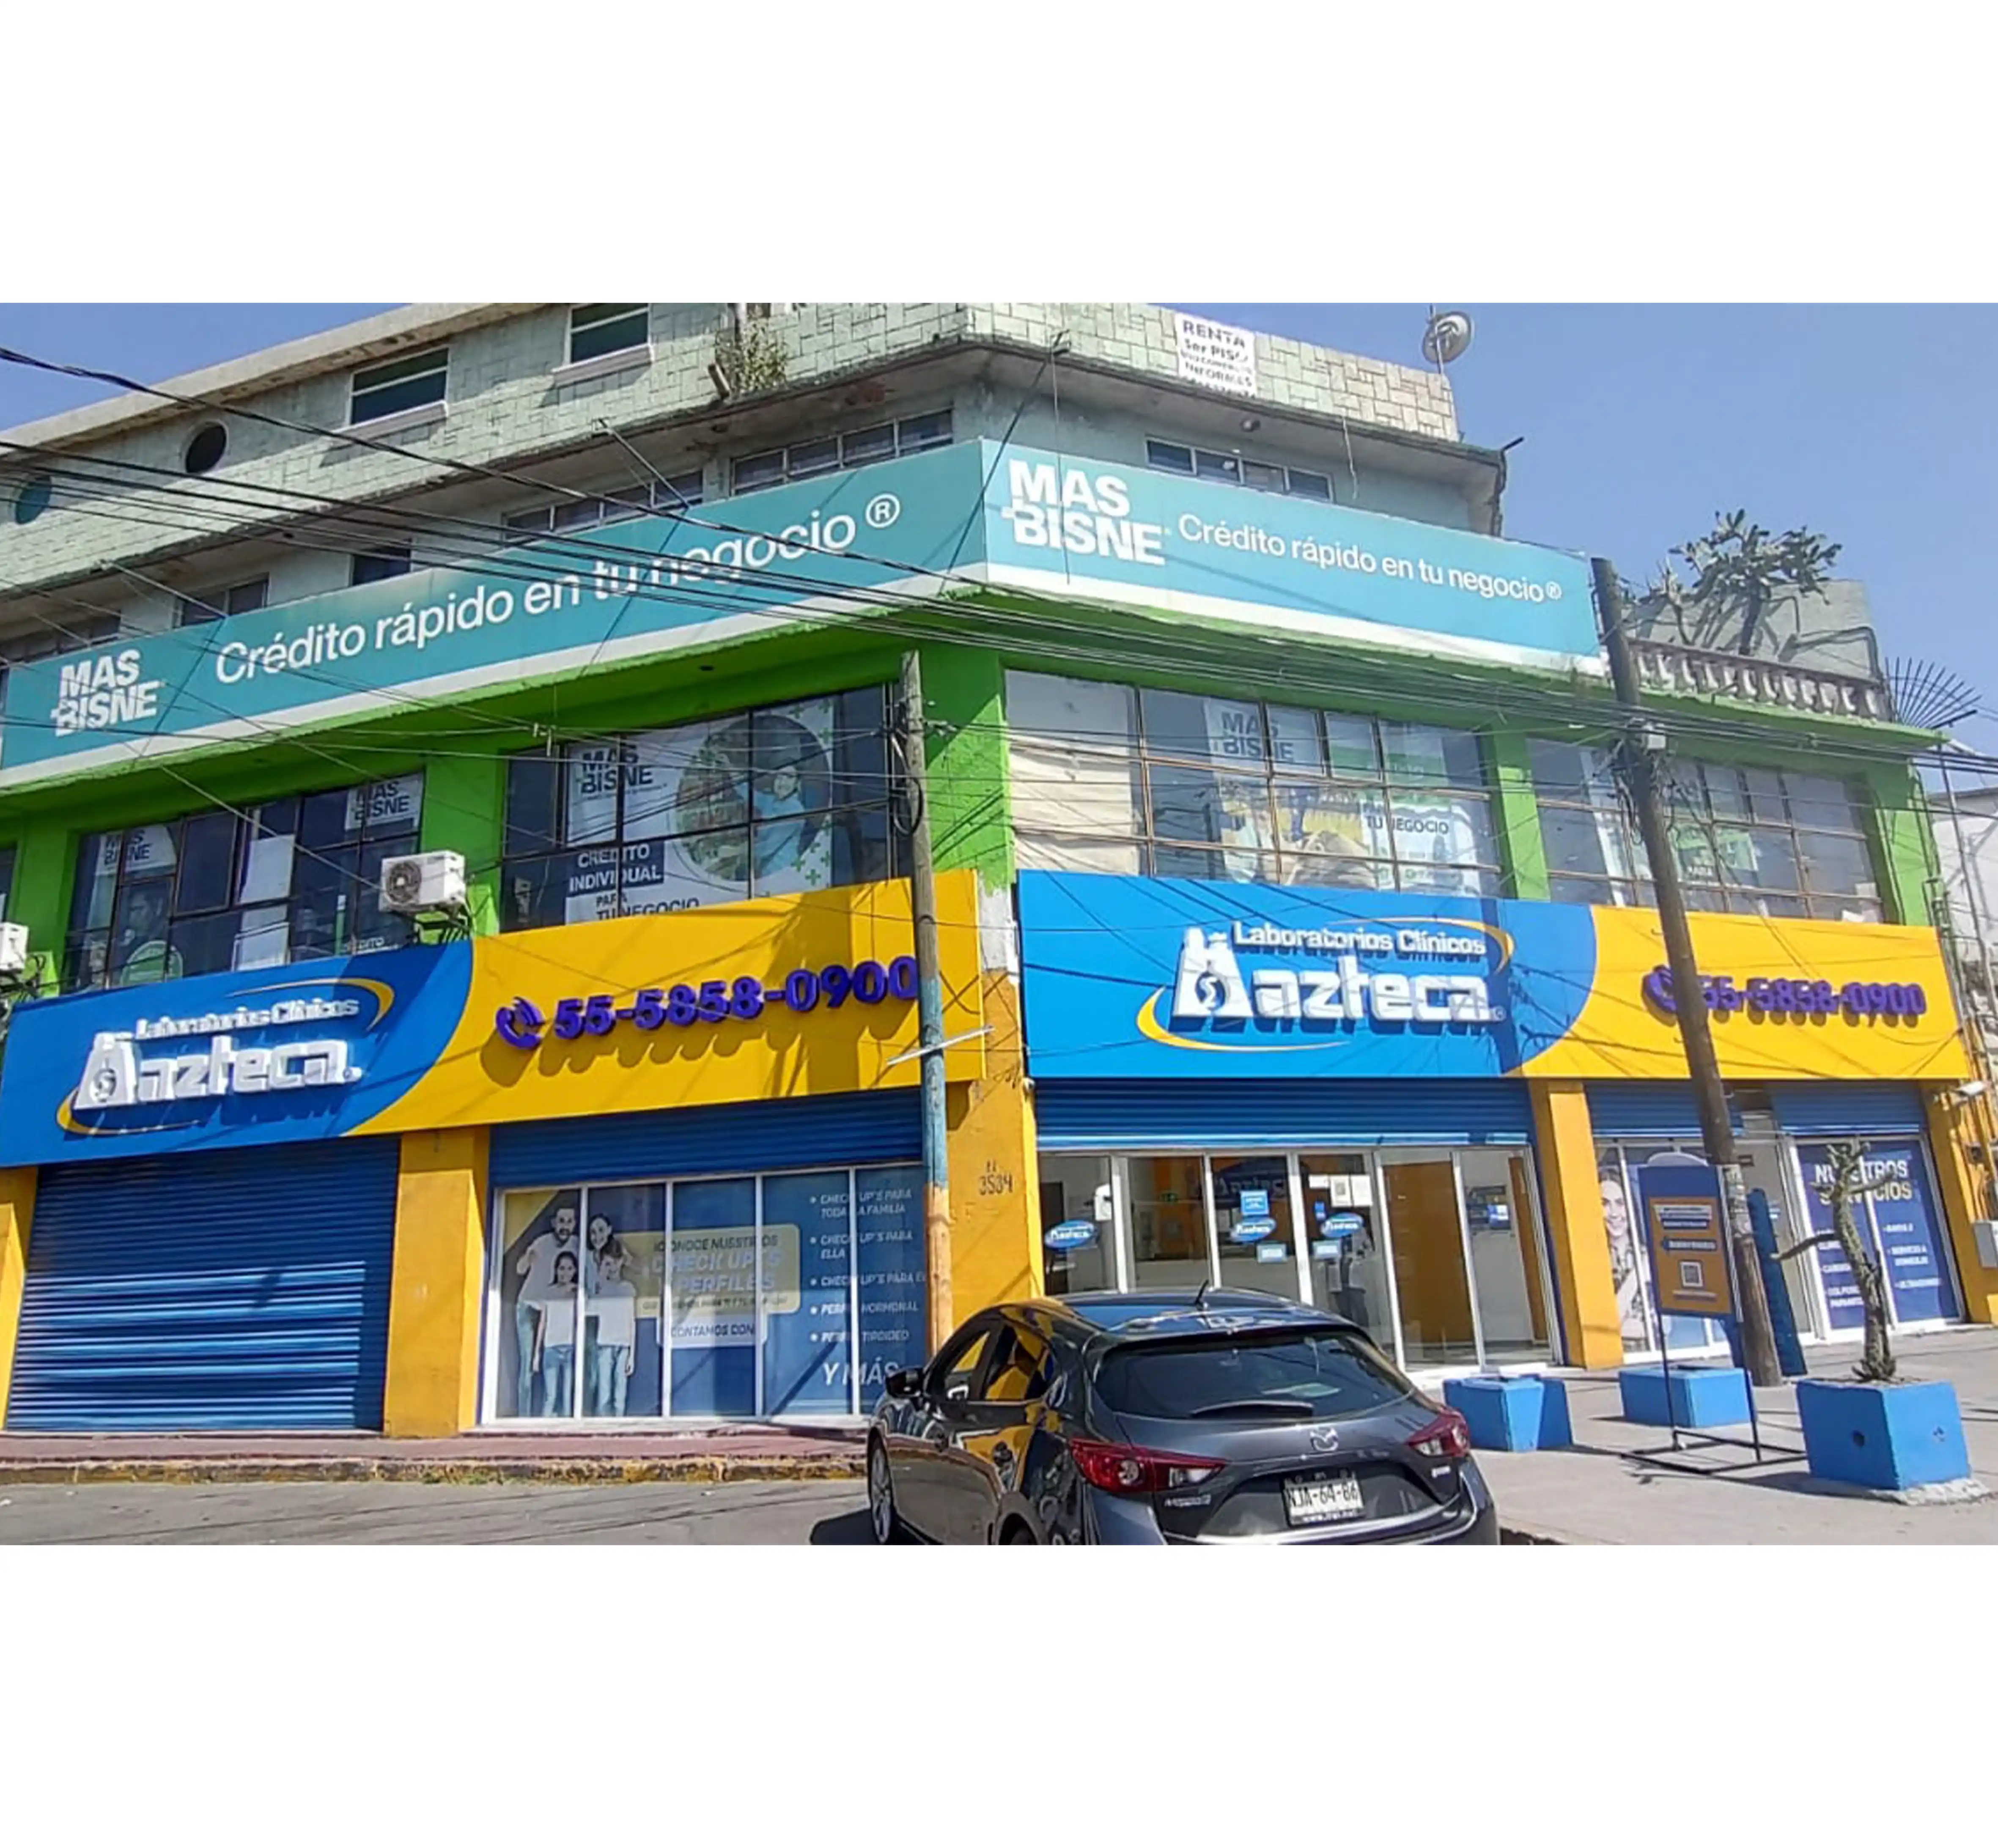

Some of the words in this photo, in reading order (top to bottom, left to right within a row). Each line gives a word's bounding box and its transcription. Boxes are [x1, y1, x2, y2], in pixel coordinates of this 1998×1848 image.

[1183, 320, 1245, 348] RENTA
[1008, 459, 1131, 518] MAS
[1001, 499, 1166, 566] BISNE
[1178, 513, 1286, 558] Crédito
[1290, 536, 1376, 575] rápido
[1382, 554, 1413, 579] en
[1418, 561, 1444, 586] tu
[217, 620, 365, 684] Crédito
[375, 581, 513, 647] rápido
[524, 576, 580, 614] en
[594, 559, 638, 600] tu
[651, 510, 857, 584] negocio
[60, 649, 142, 698] MAS
[51, 680, 161, 737] BISNE
[1233, 921, 1393, 952] Laboratorios
[1397, 927, 1486, 956] Clínicos
[136, 1006, 270, 1040] Laboratorios
[271, 997, 360, 1024] Clínicos
[553, 955, 919, 1040] 55-5858-0900
[978, 1174, 1013, 1196] 3534
[820, 1248, 846, 1260] ELLA
[823, 1362, 840, 1386] Y
